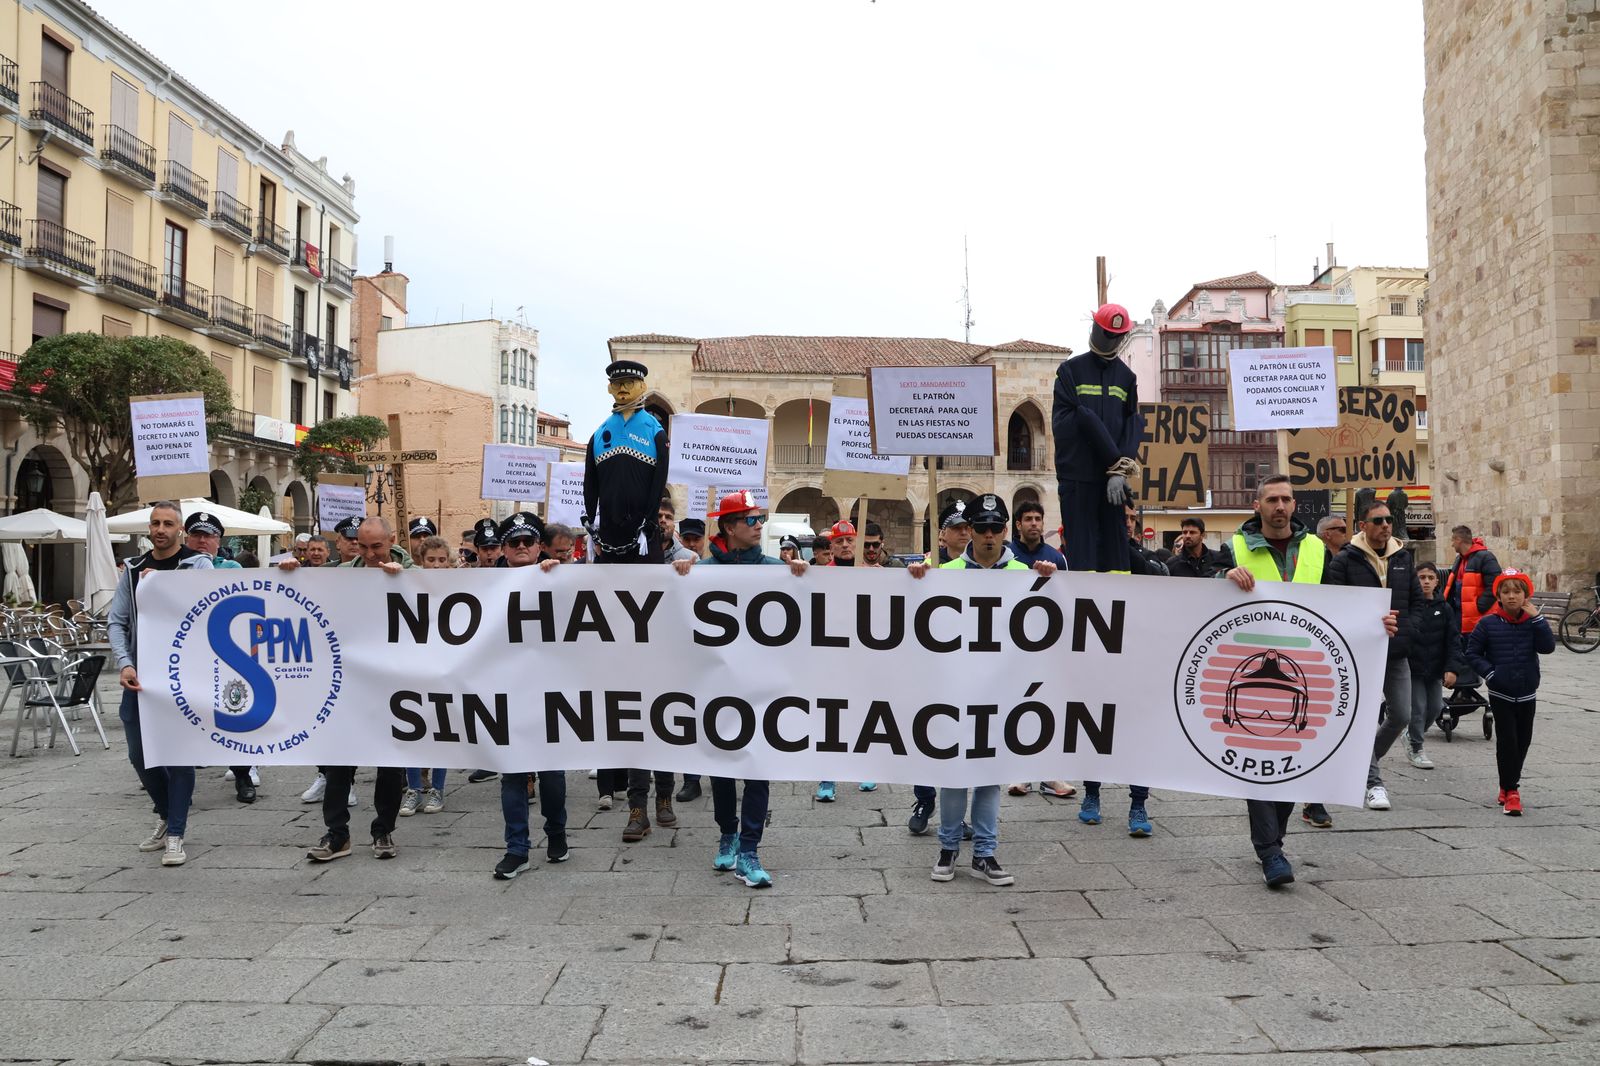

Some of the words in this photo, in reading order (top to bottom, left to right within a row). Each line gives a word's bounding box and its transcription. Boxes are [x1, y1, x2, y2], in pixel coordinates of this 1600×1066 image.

[1259, 362, 1287, 370] PATRÓN
[923, 391, 955, 400] PATRÓN
[1246, 386, 1281, 394] PODAMOS
[1283, 385, 1319, 393] CONCILIAR
[1268, 397, 1311, 405] AYUDARNOS
[889, 406, 934, 414] DECRETARÁ
[961, 407, 978, 415] QUE
[152, 421, 186, 429] TOMARÁS
[138, 433, 168, 441] DECRETO
[928, 432, 973, 440] DESCANSAR
[692, 442, 720, 452] PATRÓN
[722, 445, 758, 455] REGULARÁ
[151, 453, 190, 461] EXPEDIENTE
[401, 452, 437, 462] BOMBEROS
[692, 454, 733, 464] CUADRANTE
[734, 457, 758, 466] SEGÚN
[704, 467, 742, 476] CONVENGA
[253, 580, 272, 592] DE
[276, 584, 330, 629] POLICÍAS
[172, 581, 249, 649] PROFESIONAL
[386, 592, 482, 646] NO
[507, 590, 665, 644] HAY
[693, 576, 1126, 654] SOLUCIÓN
[1185, 645, 1208, 706] SINDICATO
[1206, 611, 1287, 646] PROFESIONAL
[1289, 615, 1344, 665] BOMBEROS
[1335, 666, 1350, 718] ZAMORA
[316, 630, 343, 724] MUNICIPALES
[168, 653, 202, 726] SINDICATO
[389, 690, 509, 746] SIN
[544, 682, 1117, 760] NEGOCIACIÓN
[210, 732, 265, 755] CASTILLA
[267, 743, 276, 755] Y
[279, 730, 310, 752] LEÓN
[1221, 749, 1302, 777] S.P.B.Z.
